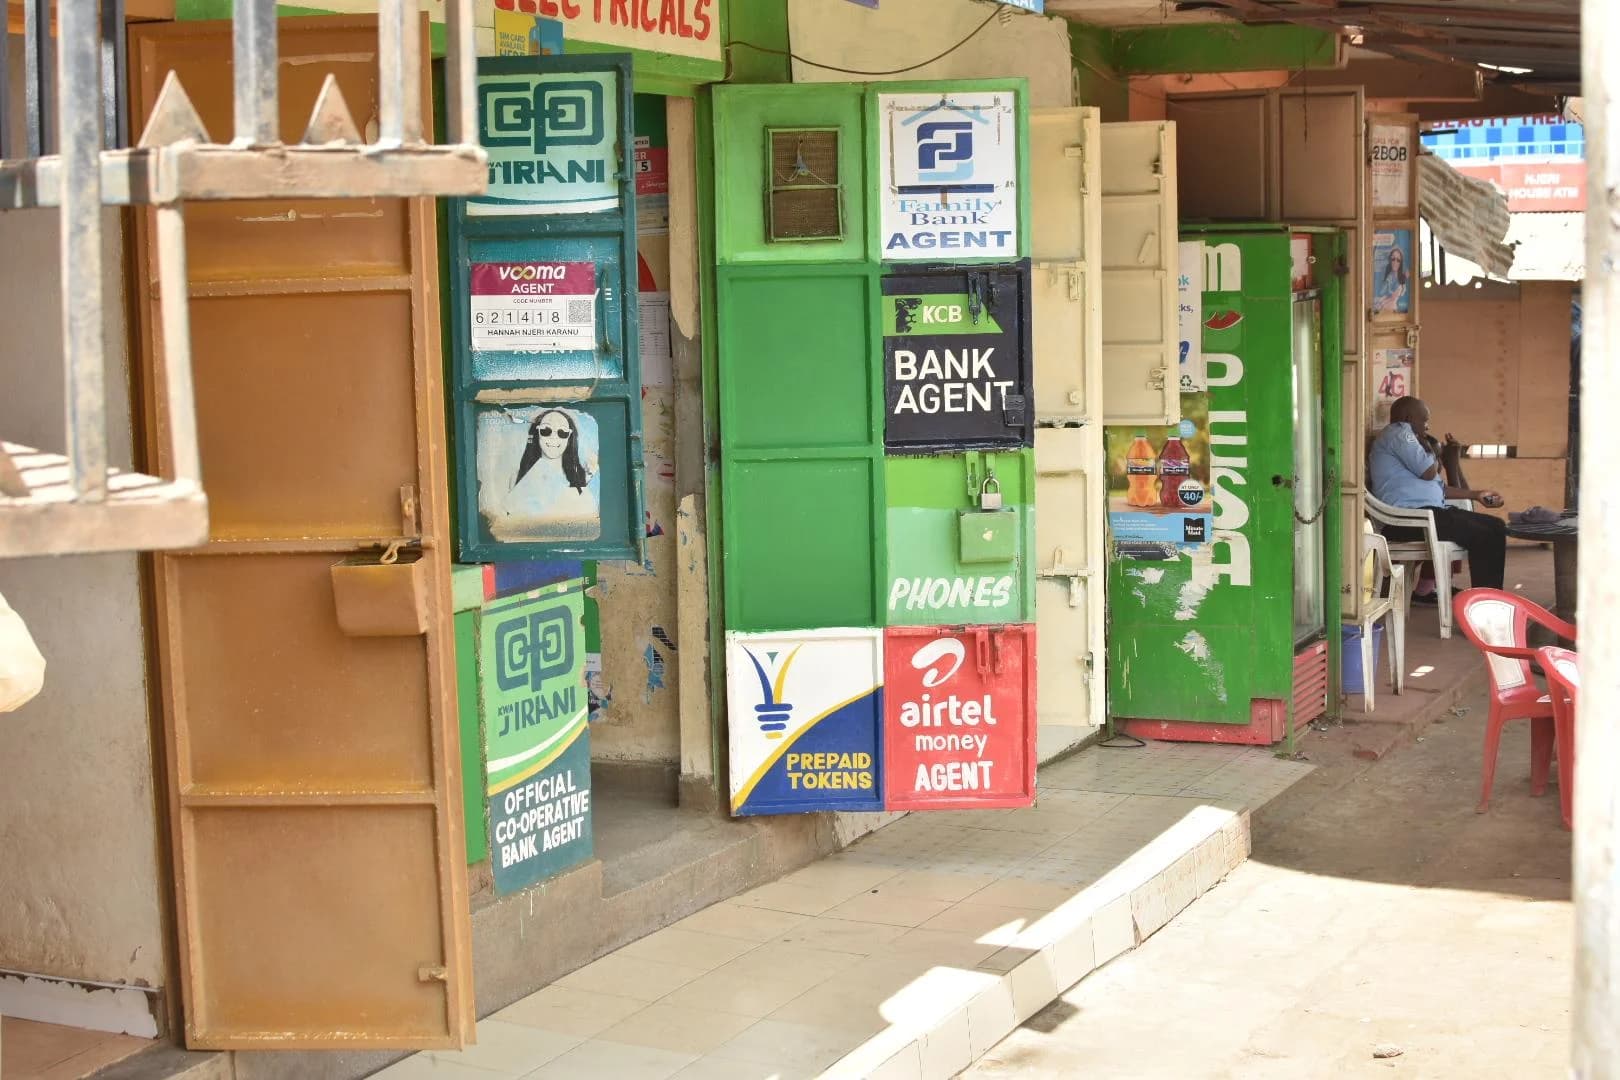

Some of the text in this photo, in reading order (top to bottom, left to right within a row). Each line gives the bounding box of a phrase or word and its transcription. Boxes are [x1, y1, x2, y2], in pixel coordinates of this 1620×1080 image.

[494, 0, 712, 41] TRICALS
[899, 198, 1001, 214] Family
[910, 211, 989, 225] Bank
[886, 231, 1012, 249] AGENT
[499, 265, 566, 281] vooma
[511, 283, 555, 294] AGENT
[922, 305, 962, 324] KCB
[894, 348, 996, 381] BANK
[894, 381, 1014, 414] AGENT
[889, 575, 1013, 611] PHONES
[498, 704, 513, 717] KWA
[499, 685, 576, 738] JIRANI
[899, 694, 997, 728] airtel
[915, 733, 988, 759] money
[786, 752, 872, 770] PREPAID
[787, 771, 873, 790] TOKENS
[914, 760, 994, 792] AGENT
[504, 769, 577, 816] OFFICIAL
[495, 789, 590, 844] CO-OPERATIVE
[501, 815, 585, 869] BANK AGENT
